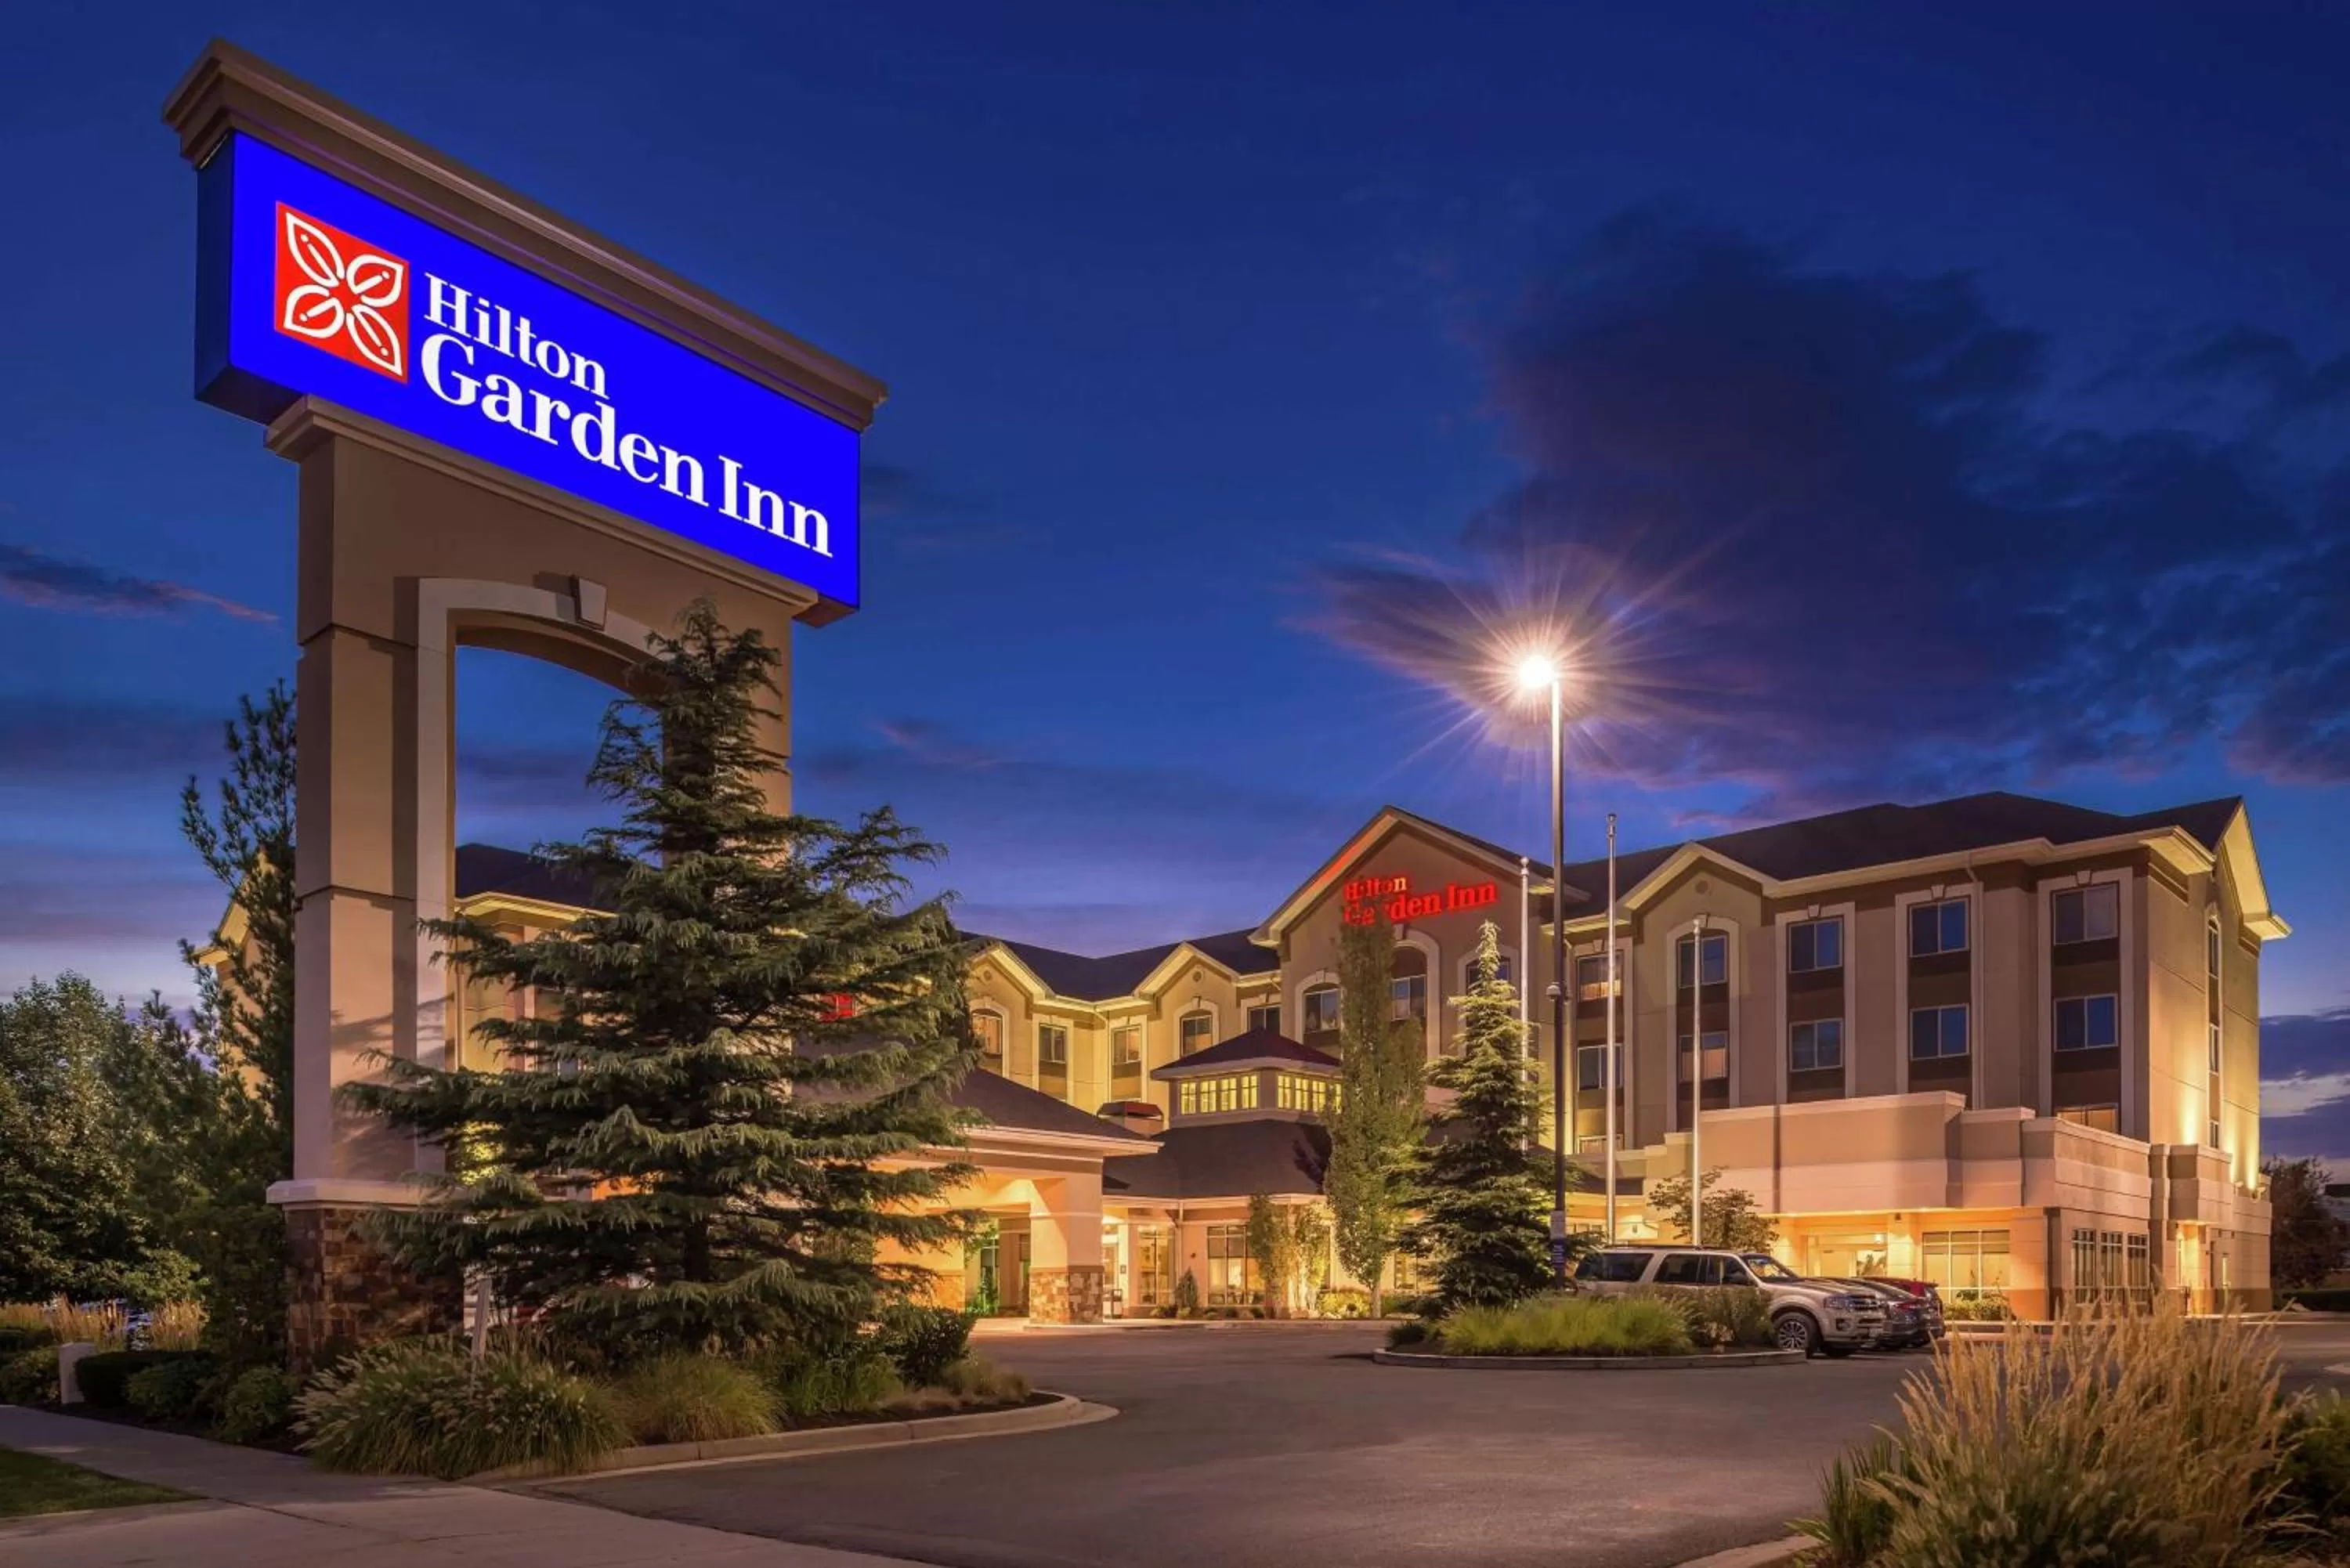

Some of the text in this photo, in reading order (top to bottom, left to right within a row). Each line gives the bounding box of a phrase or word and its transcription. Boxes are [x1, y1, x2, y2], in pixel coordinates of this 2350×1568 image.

[423, 273, 609, 399] Hilton
[421, 333, 833, 558] Garden Inn
[1343, 883, 1496, 924] Gaden Inn
